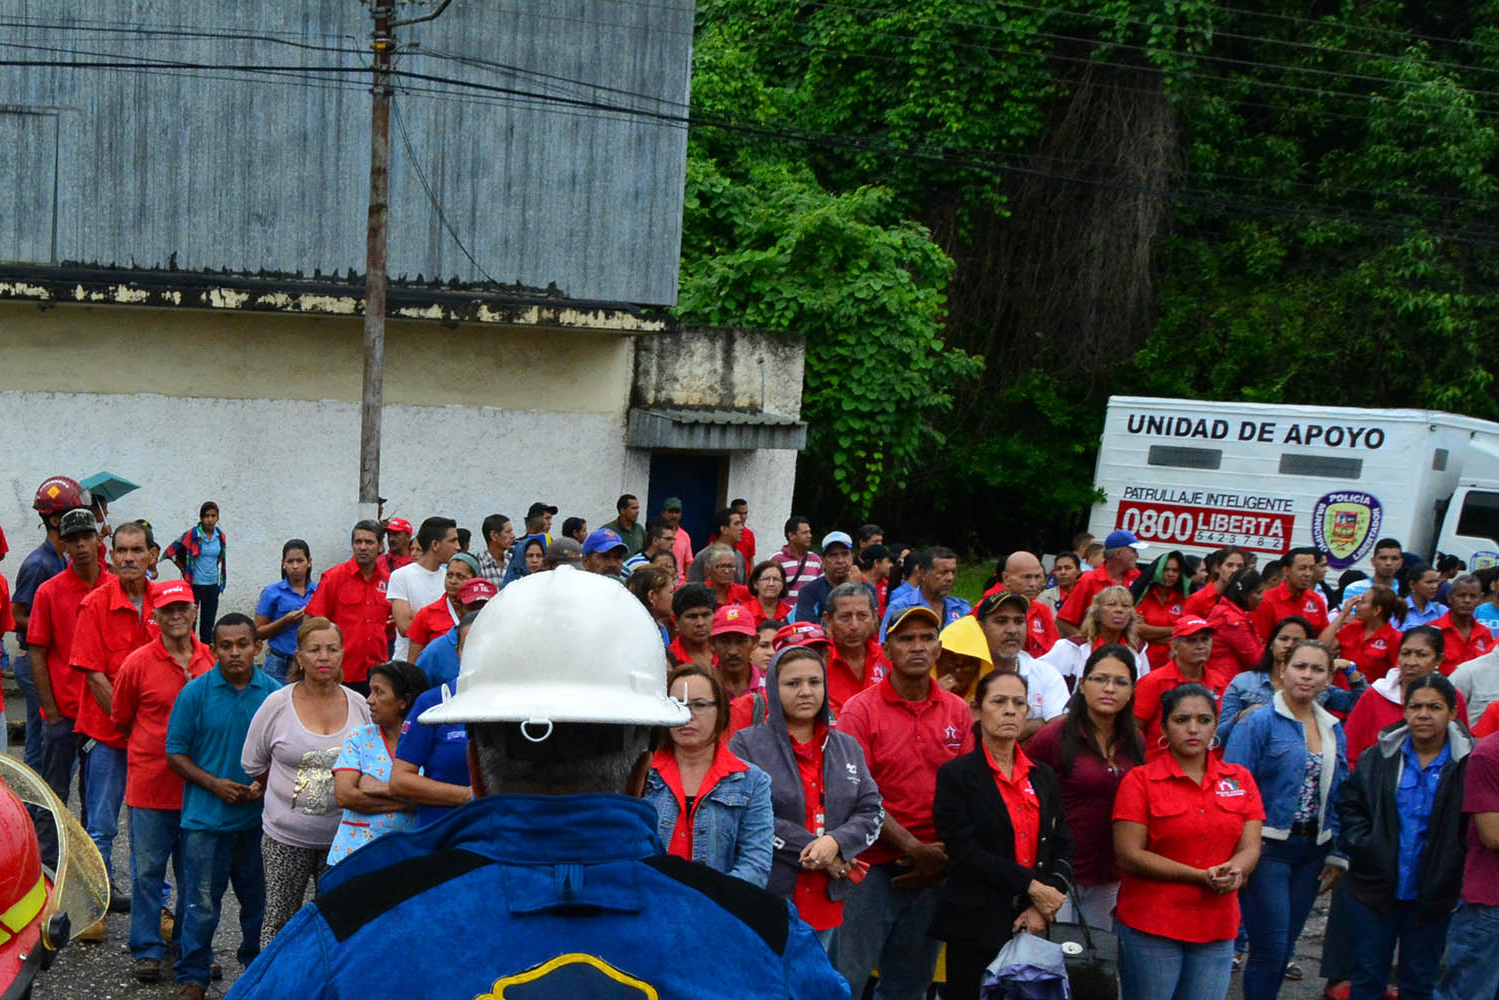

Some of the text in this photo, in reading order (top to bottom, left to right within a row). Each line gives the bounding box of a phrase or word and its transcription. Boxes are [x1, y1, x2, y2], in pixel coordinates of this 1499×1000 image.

[1126, 414, 1386, 450] UNIDAD DE APOYO
[1123, 486, 1294, 512] PATRULLAJE INTELIGENTE
[1121, 507, 1284, 542] 0800 LIBERTA
